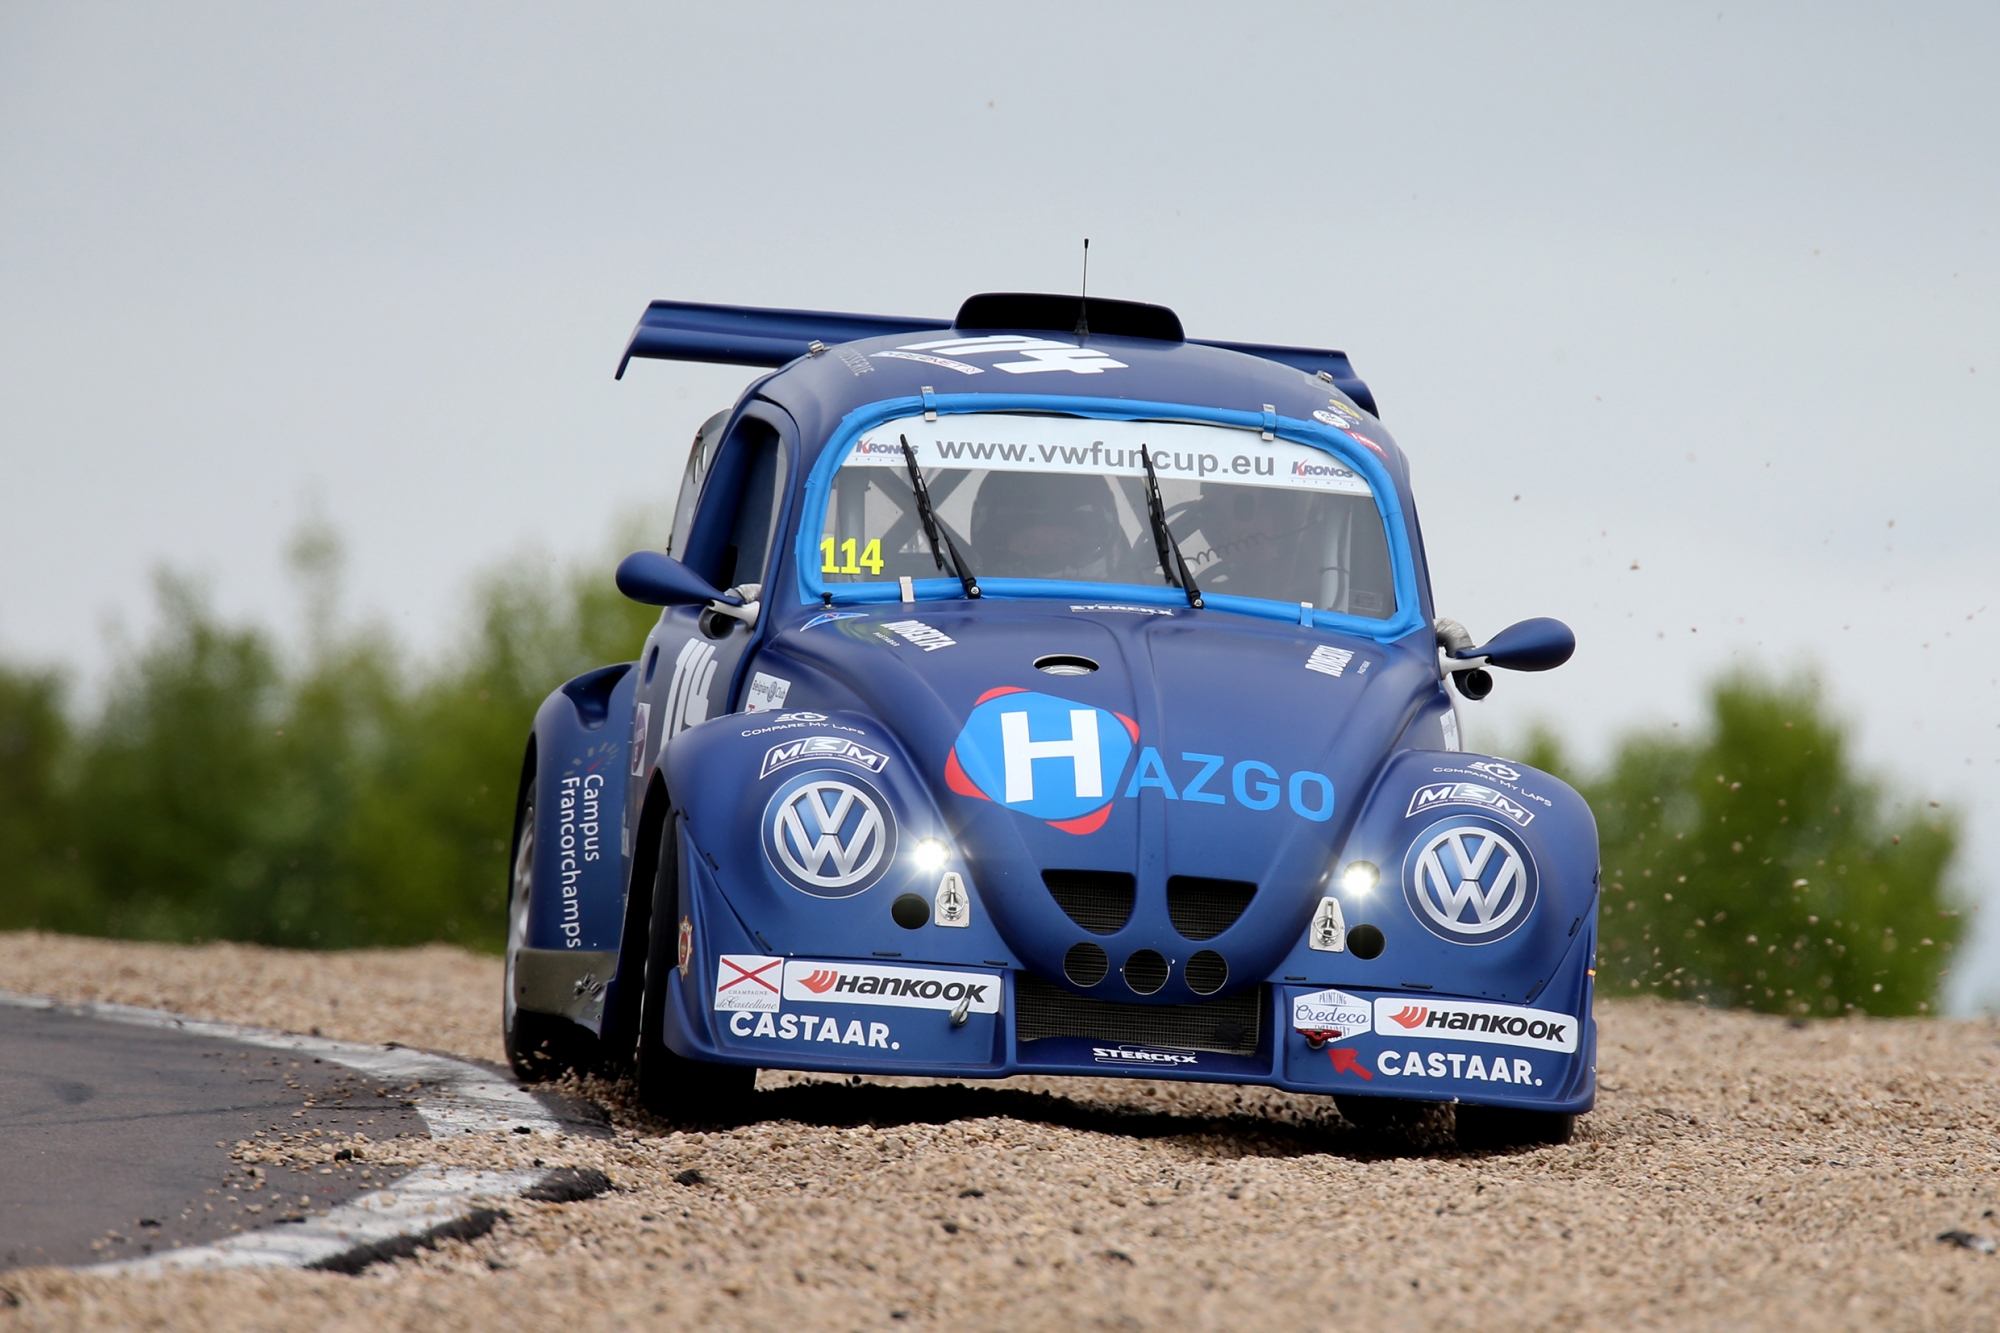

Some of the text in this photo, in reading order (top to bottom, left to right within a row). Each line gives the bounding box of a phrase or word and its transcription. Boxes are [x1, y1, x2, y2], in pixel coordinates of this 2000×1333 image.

[935, 440, 1275, 476] www.vwfuncup.eu
[1291, 459, 1354, 478] KRONOS
[820, 537, 885, 575] 114
[741, 723, 806, 738] COMPARE
[832, 723, 866, 736] LAPS
[1432, 766, 1552, 808] COMPARE MY LAPS
[579, 774, 604, 862] Campus
[560, 777, 582, 948] Francorchamps
[729, 1011, 900, 1051] CASTAAR.
[1296, 1004, 1370, 1024] Credeco
[1092, 1047, 1199, 1064] STERCKX
[1377, 1050, 1543, 1086] CASTAAR.
